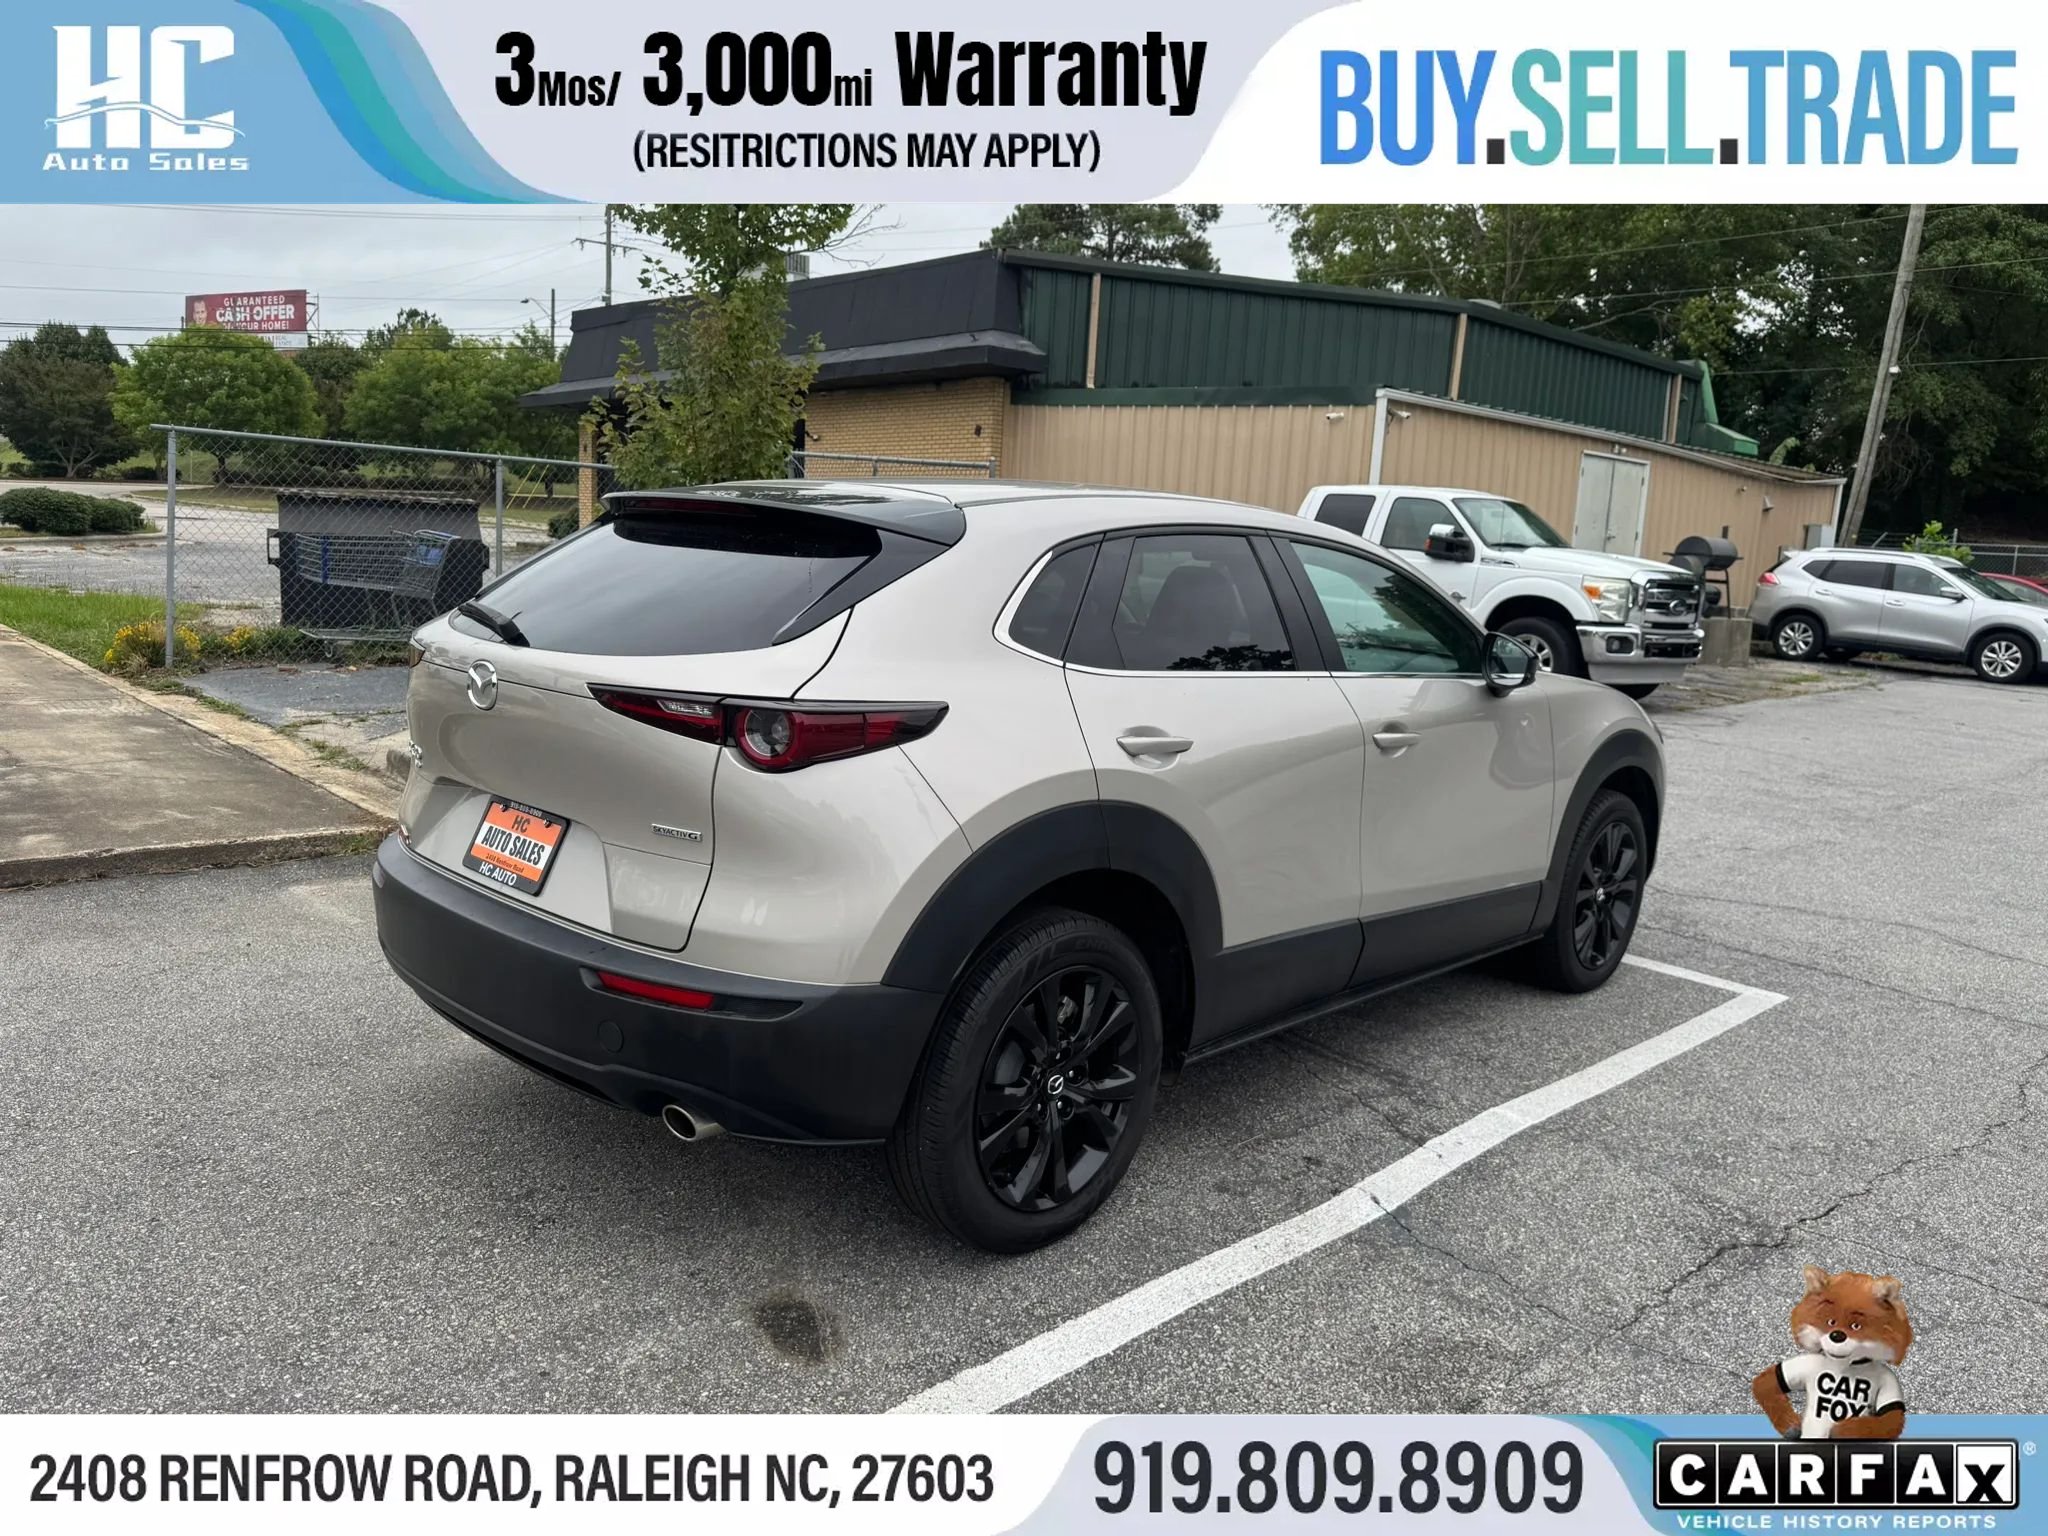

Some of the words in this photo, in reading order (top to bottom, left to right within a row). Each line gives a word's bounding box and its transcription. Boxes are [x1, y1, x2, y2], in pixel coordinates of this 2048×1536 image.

[216, 306, 250, 322] CASH
[253, 304, 295, 321] OFFER
[511, 815, 530, 833] HC
[481, 825, 513, 853] AUTO
[509, 835, 545, 866] SALES
[479, 861, 494, 876] HC
[491, 867, 518, 886] AUTO
